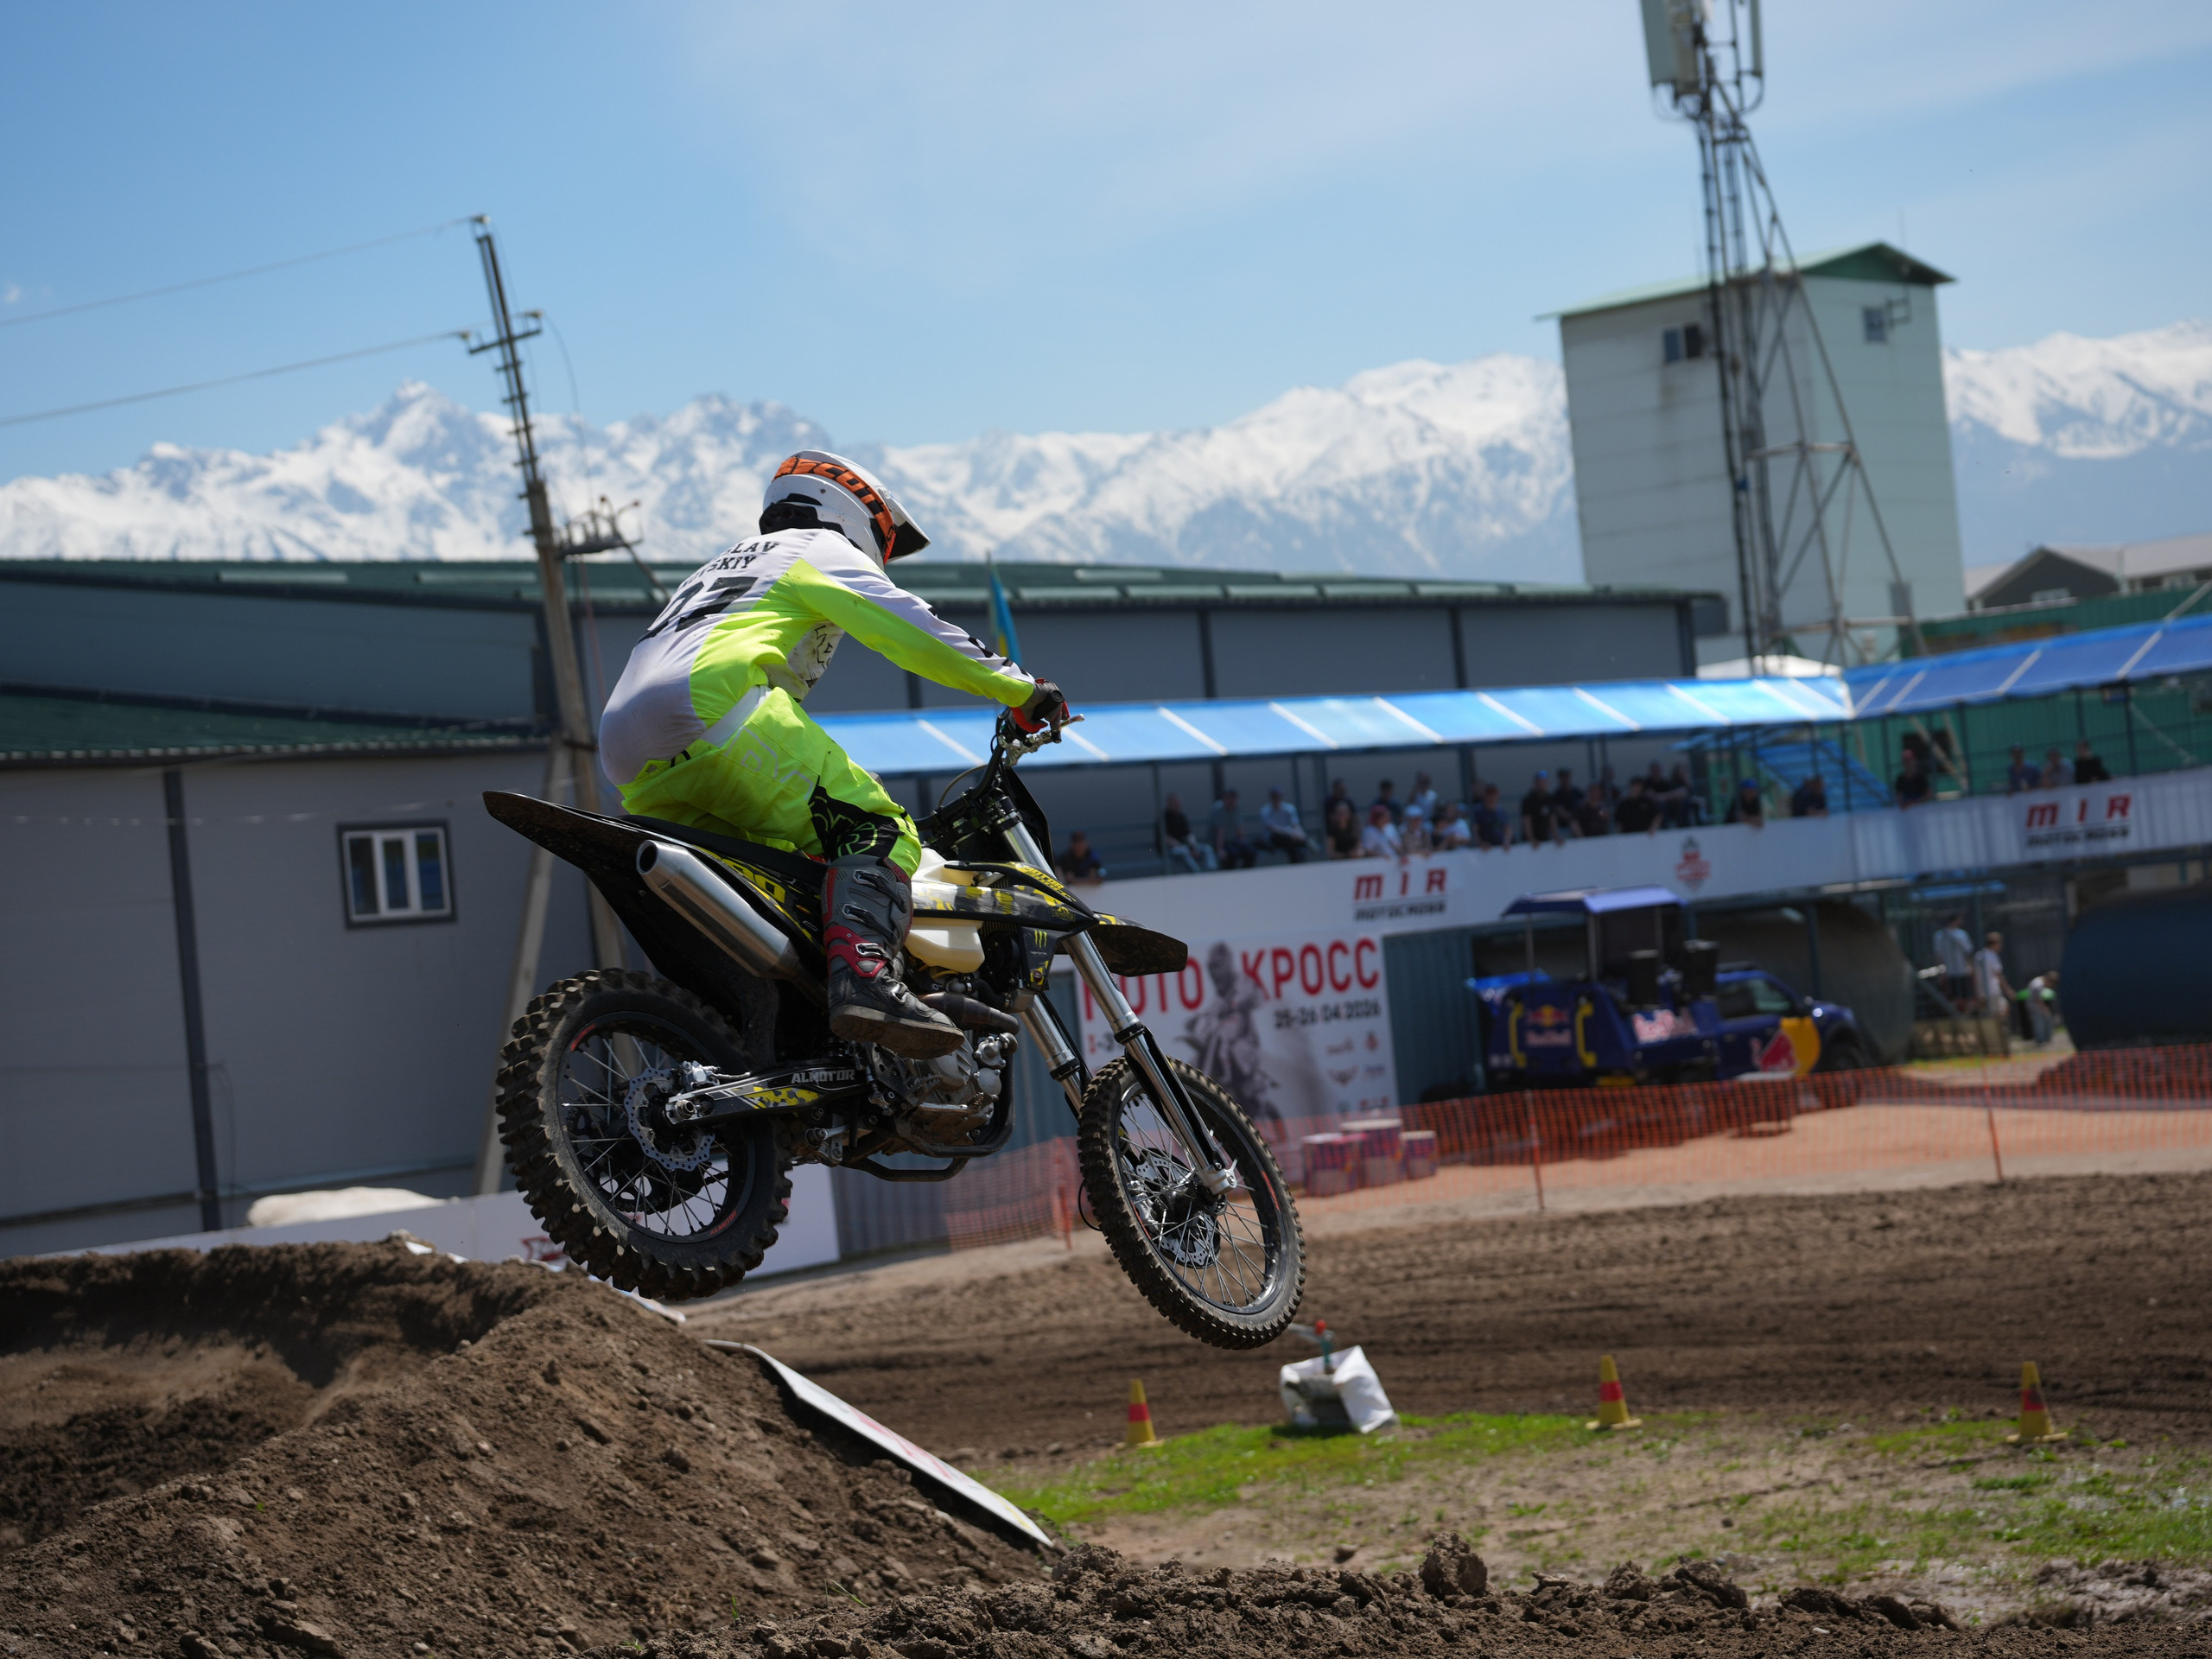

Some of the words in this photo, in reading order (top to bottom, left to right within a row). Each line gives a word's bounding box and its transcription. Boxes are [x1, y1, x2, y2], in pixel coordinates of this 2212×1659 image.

[1354, 868, 1446, 900] MIR
[1241, 937, 1379, 1000] КРОСС
[791, 1069, 855, 1084] ALMOTOR
